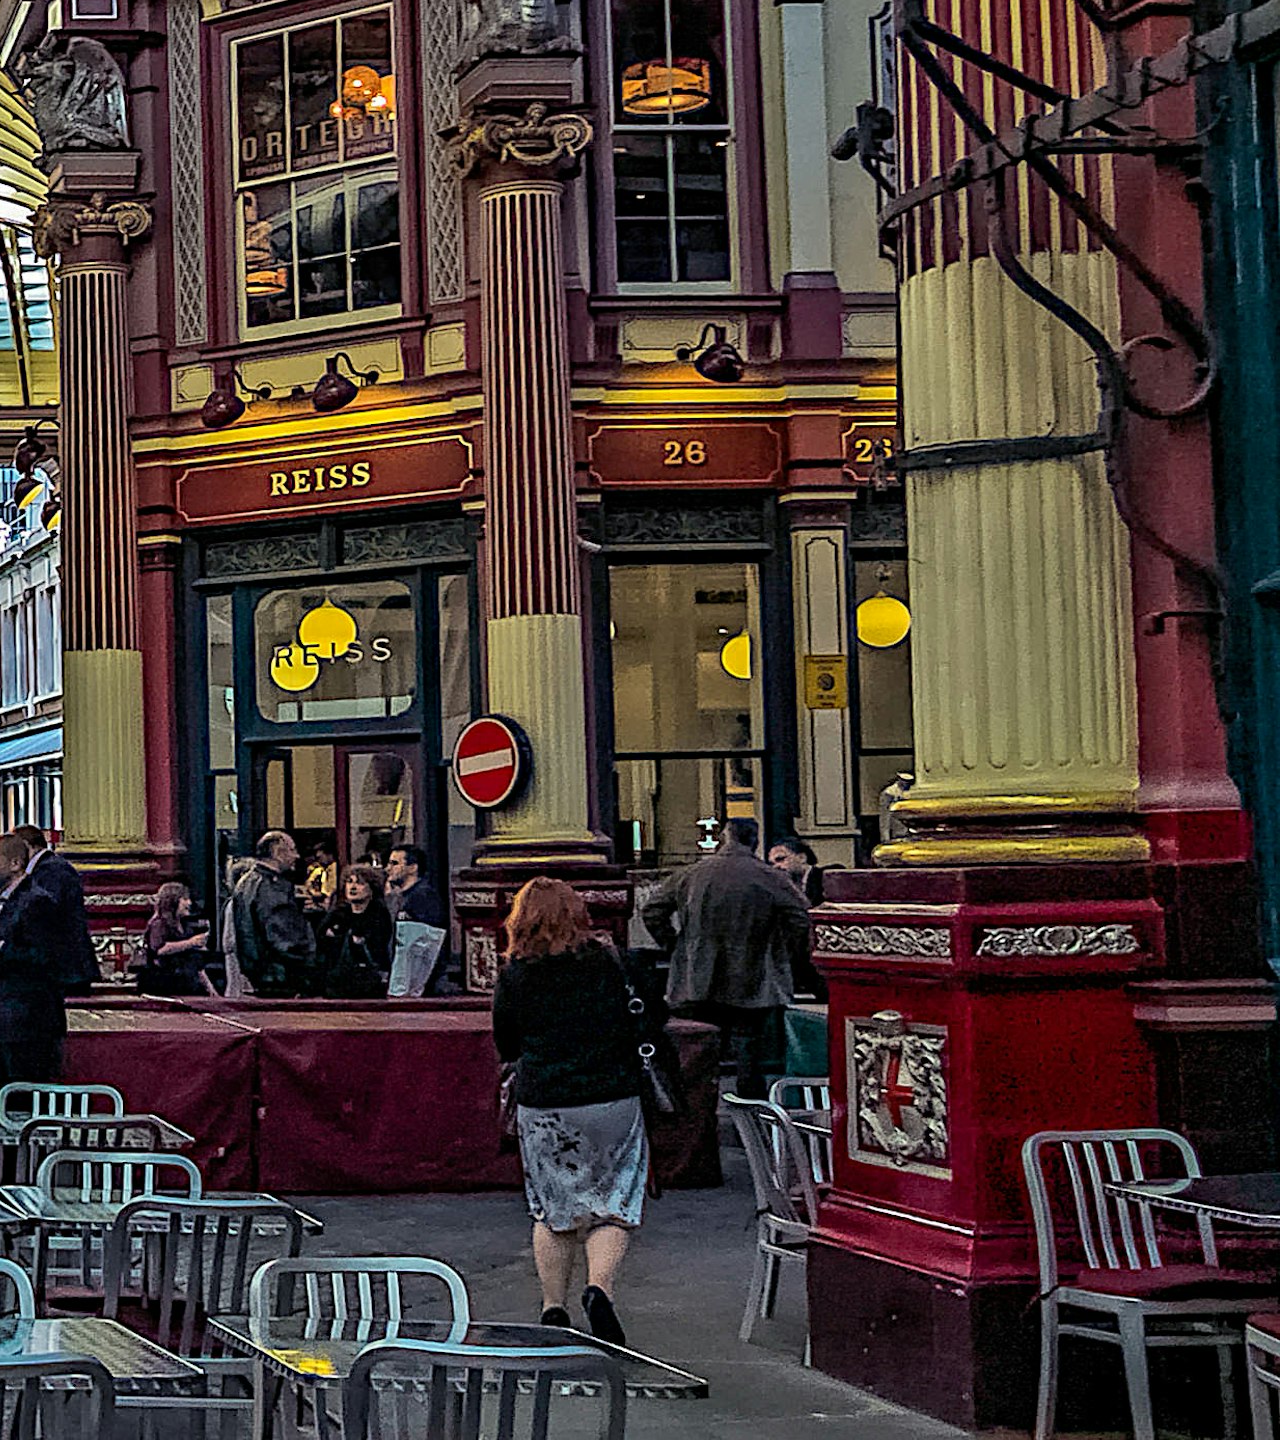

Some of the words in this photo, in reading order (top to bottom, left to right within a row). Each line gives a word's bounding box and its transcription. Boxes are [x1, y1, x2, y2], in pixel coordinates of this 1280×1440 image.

[663, 441, 707, 466] 26
[269, 462, 371, 496] REISS
[273, 637, 393, 669] REISS
